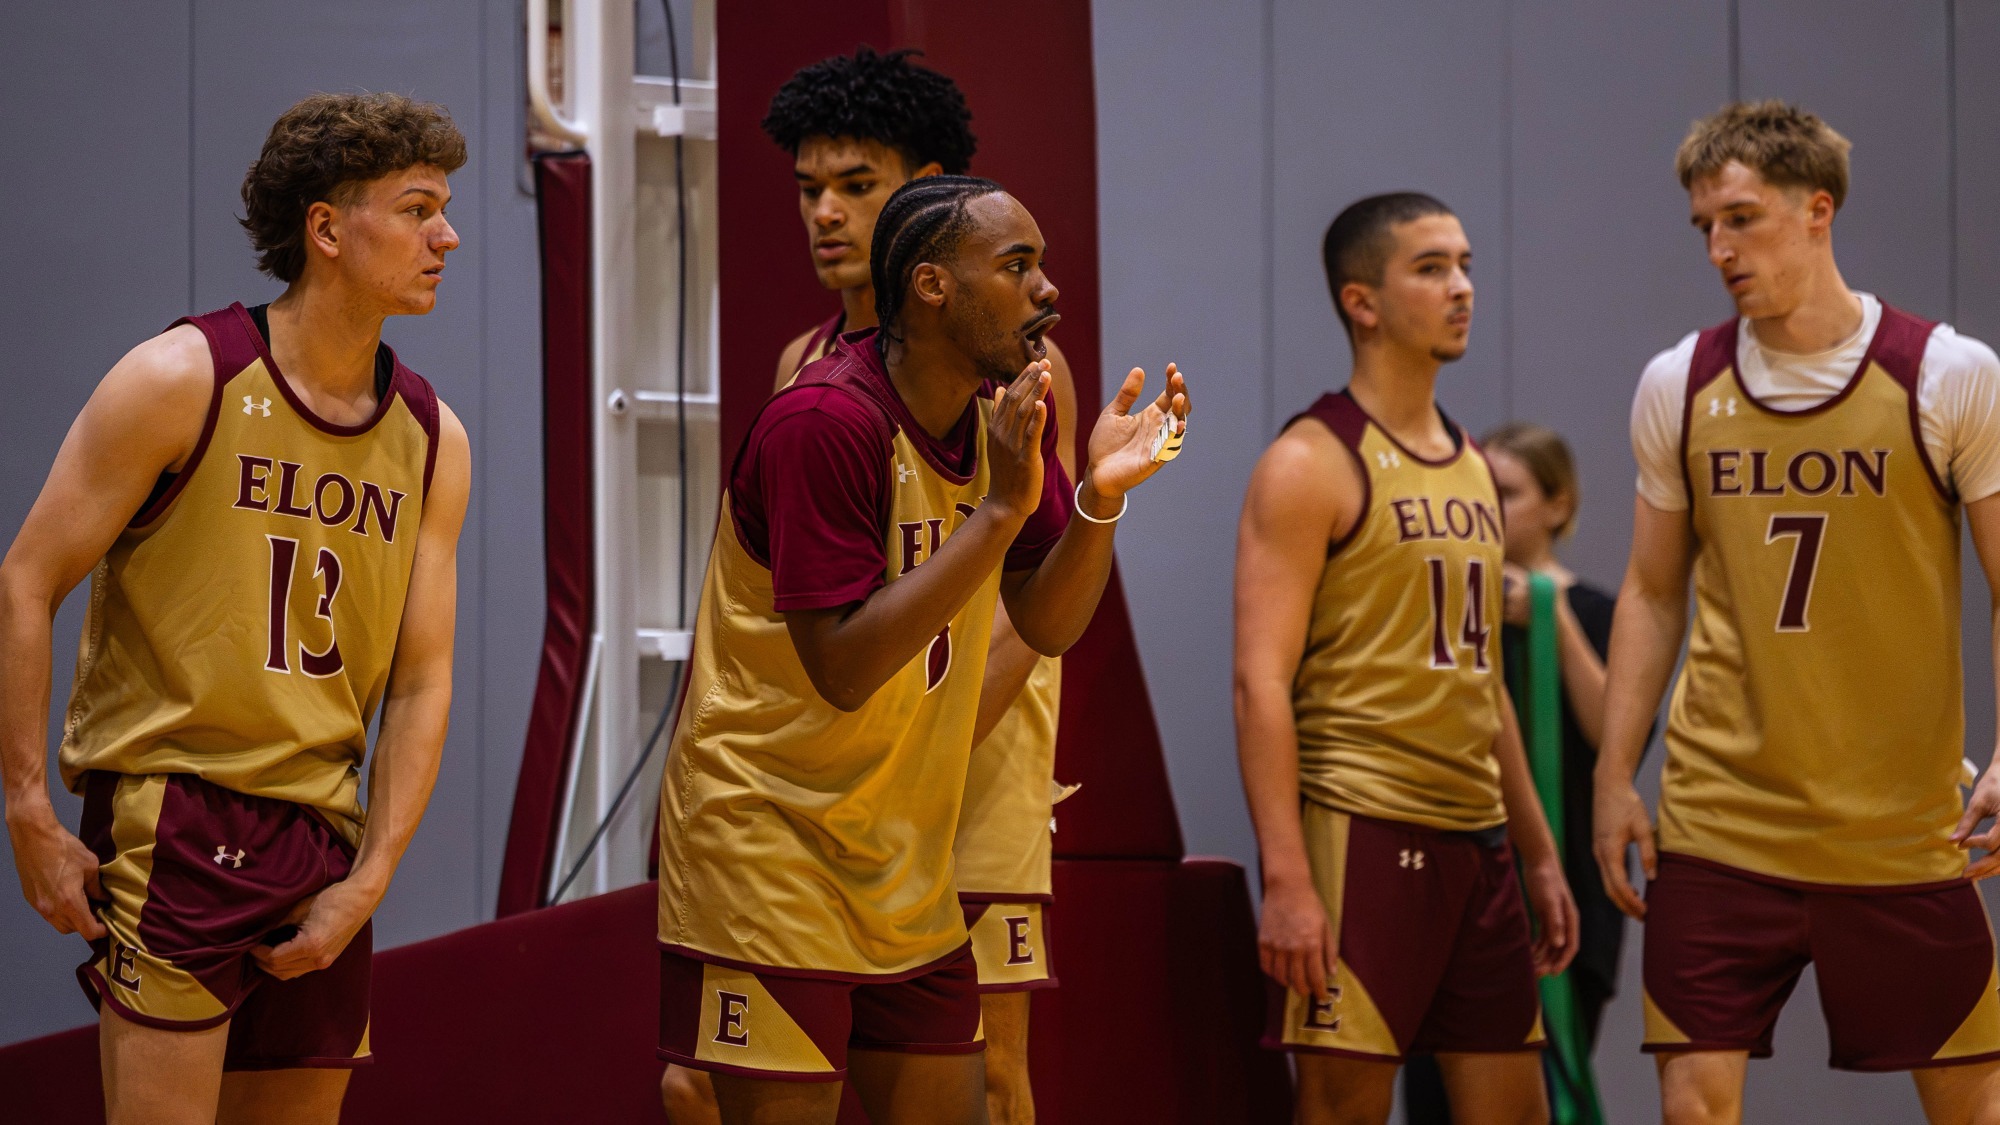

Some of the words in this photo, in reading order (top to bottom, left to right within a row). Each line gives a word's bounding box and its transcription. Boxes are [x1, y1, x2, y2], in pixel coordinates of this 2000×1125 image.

[231, 453, 408, 544] ELON
[1706, 448, 1889, 498] ELON
[1390, 497, 1501, 544] ELON
[1764, 512, 1829, 634] 7
[263, 533, 343, 679] 13
[1424, 556, 1493, 674] 14
[110, 941, 141, 995] E
[1002, 915, 1035, 967] E
[713, 989, 749, 1048] E
[1298, 984, 1343, 1034] E
